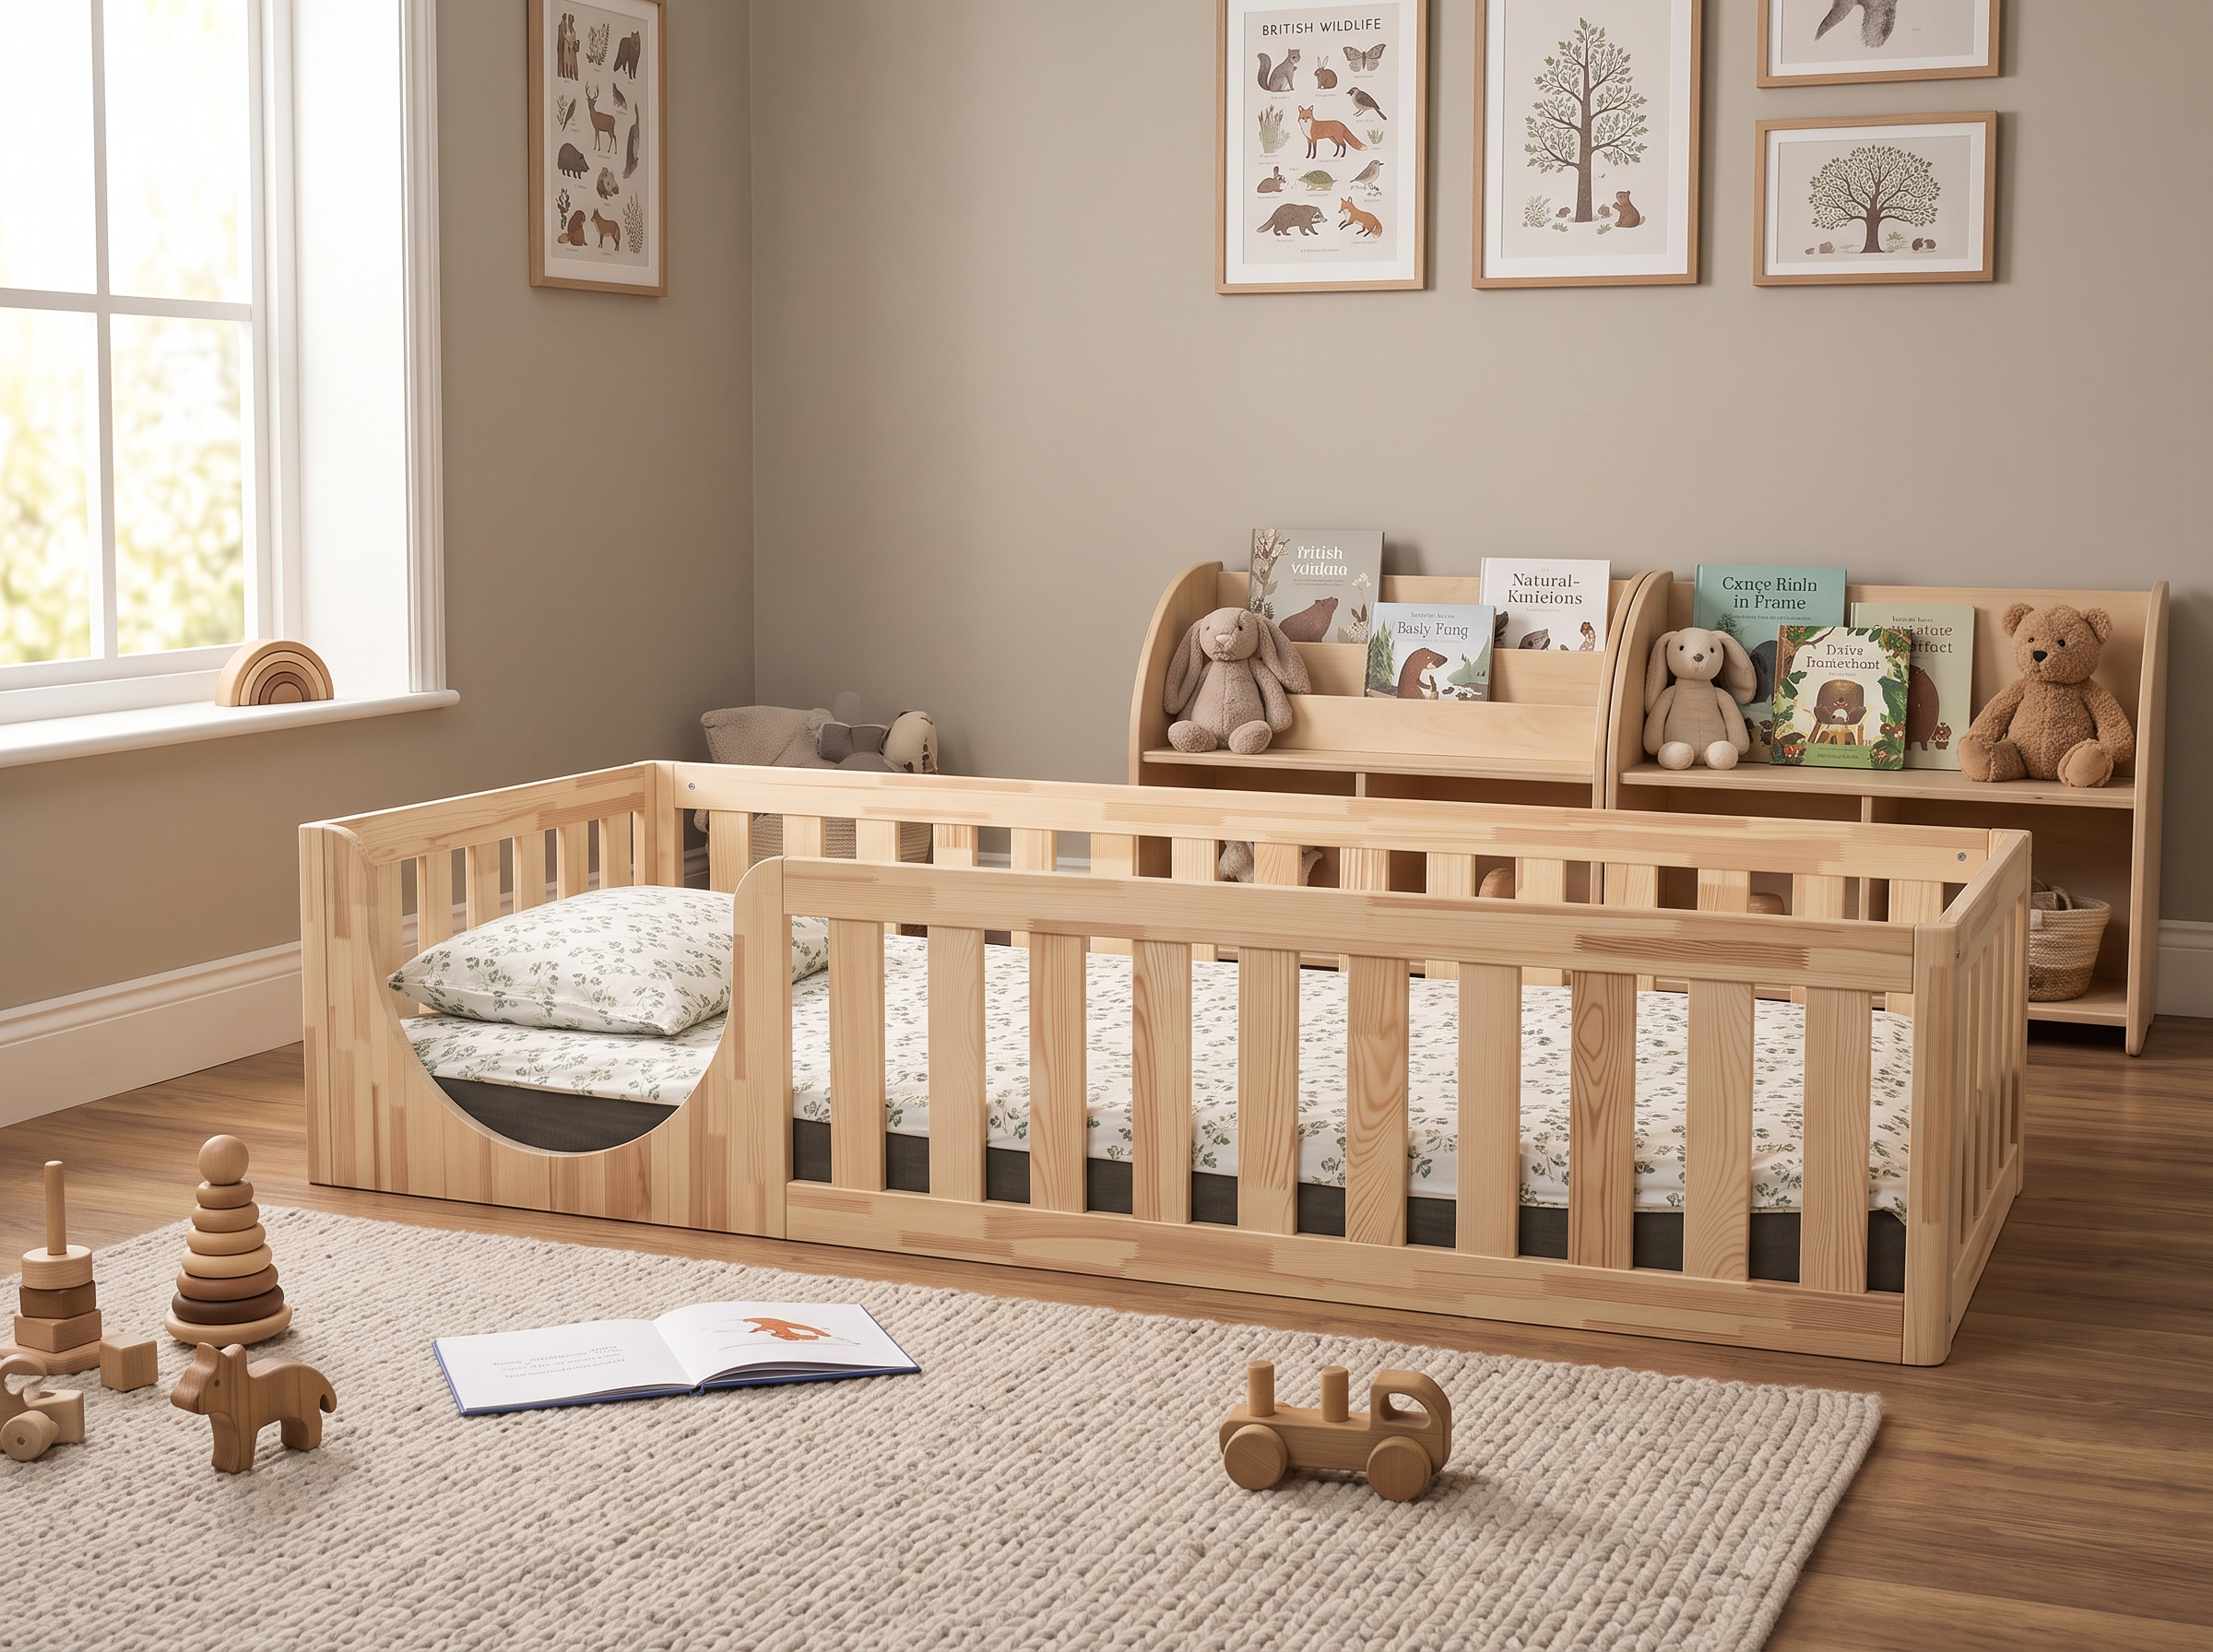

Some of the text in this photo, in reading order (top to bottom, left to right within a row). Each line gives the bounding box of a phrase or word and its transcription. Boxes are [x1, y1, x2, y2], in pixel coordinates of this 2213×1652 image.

[1262, 18, 1381, 36] BRITISH WILDLIFE
[1511, 572, 1580, 587] Natural-
[1734, 594, 1749, 608] in
[1397, 621, 1431, 639] Basly
